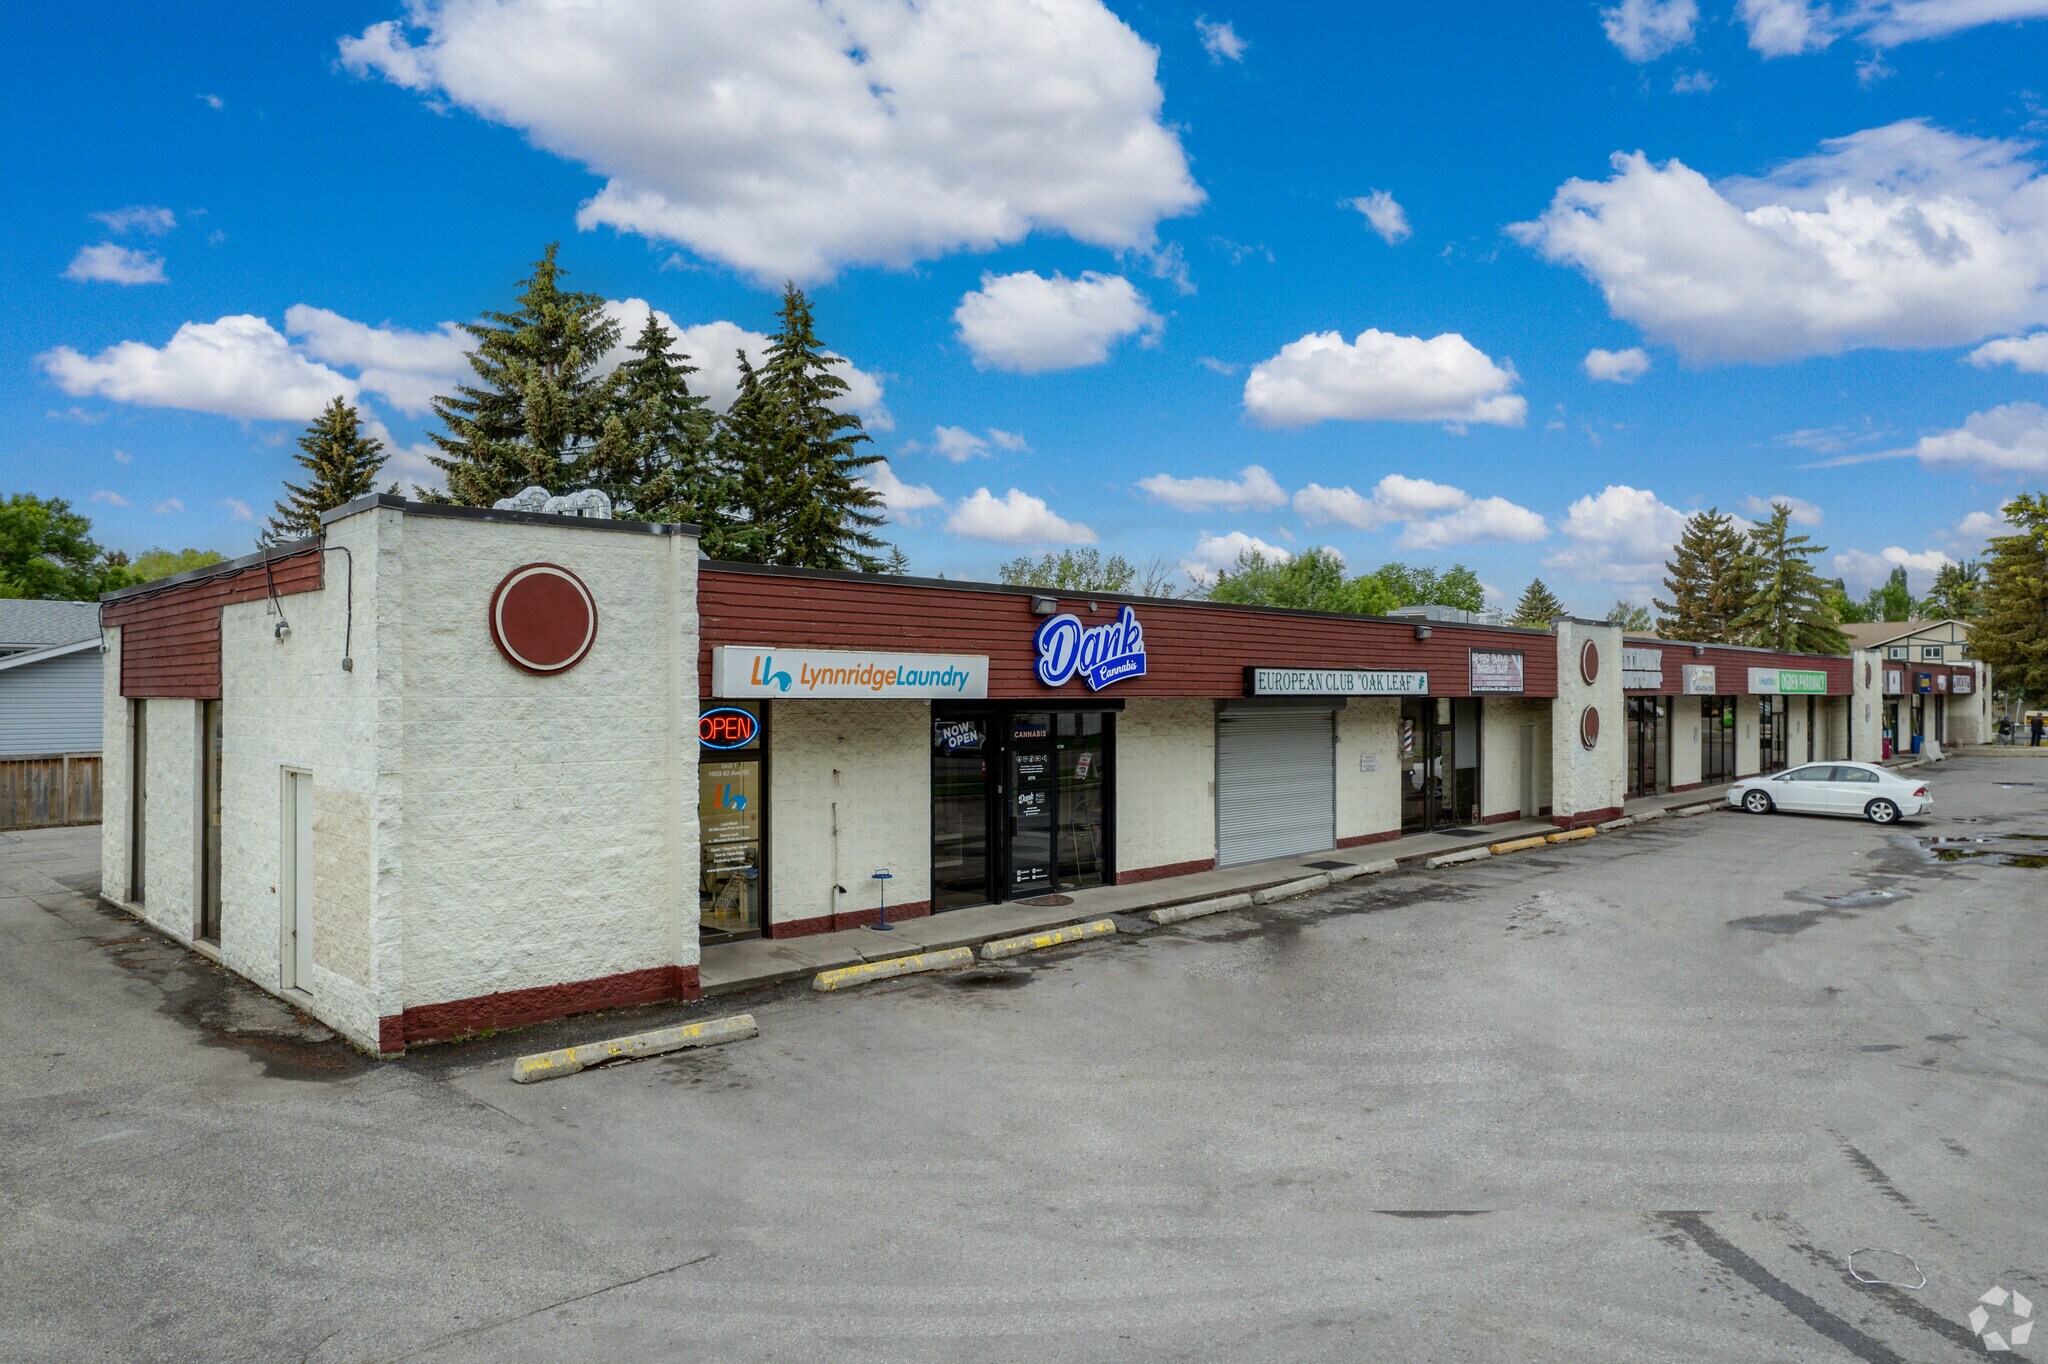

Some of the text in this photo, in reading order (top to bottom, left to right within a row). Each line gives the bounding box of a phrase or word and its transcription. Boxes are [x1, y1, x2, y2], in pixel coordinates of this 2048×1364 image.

[1039, 606, 1143, 686] Dank
[800, 662, 970, 692] LynnridgeLaundry
[1099, 659, 1138, 681] Cannabis
[1258, 671, 1323, 691] EUROPEAN
[1325, 673, 1354, 691] CLUB
[1357, 674, 1385, 691] "OAK
[1781, 673, 1799, 691] OGDEN
[1799, 673, 1825, 691] PHARMACY
[698, 717, 751, 739] OPEN
[943, 721, 969, 739] NOW
[1014, 730, 1047, 738] CANNABIS
[948, 730, 978, 747] OPEN
